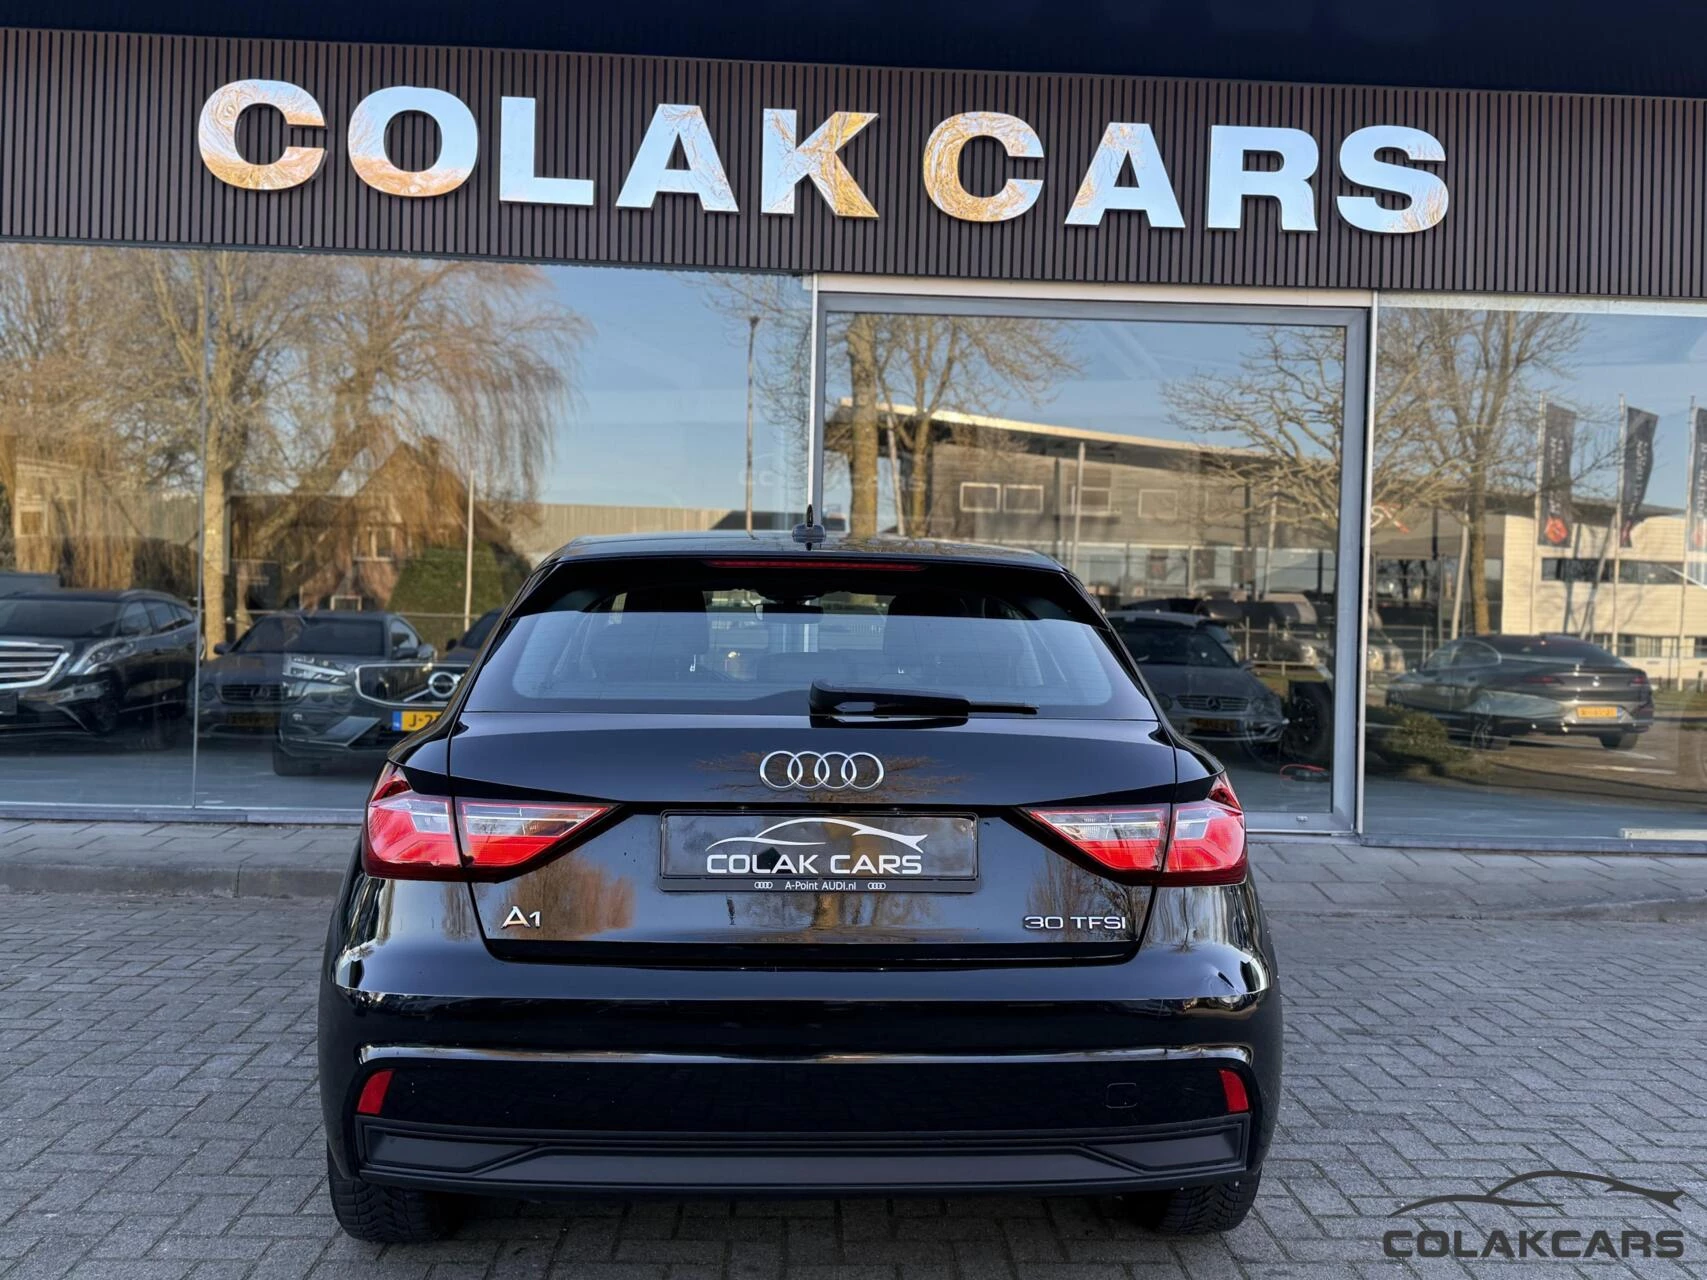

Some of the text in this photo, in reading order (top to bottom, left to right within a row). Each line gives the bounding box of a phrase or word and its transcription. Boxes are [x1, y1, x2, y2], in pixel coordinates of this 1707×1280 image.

[198, 78, 1449, 235] COLAK CARS
[407, 713, 441, 728] J-2
[706, 854, 922, 874] COLAK CARS
[784, 880, 857, 891] A-Point AUDI.nl
[500, 905, 541, 929] A1
[1024, 916, 1126, 929] 30 TFSI
